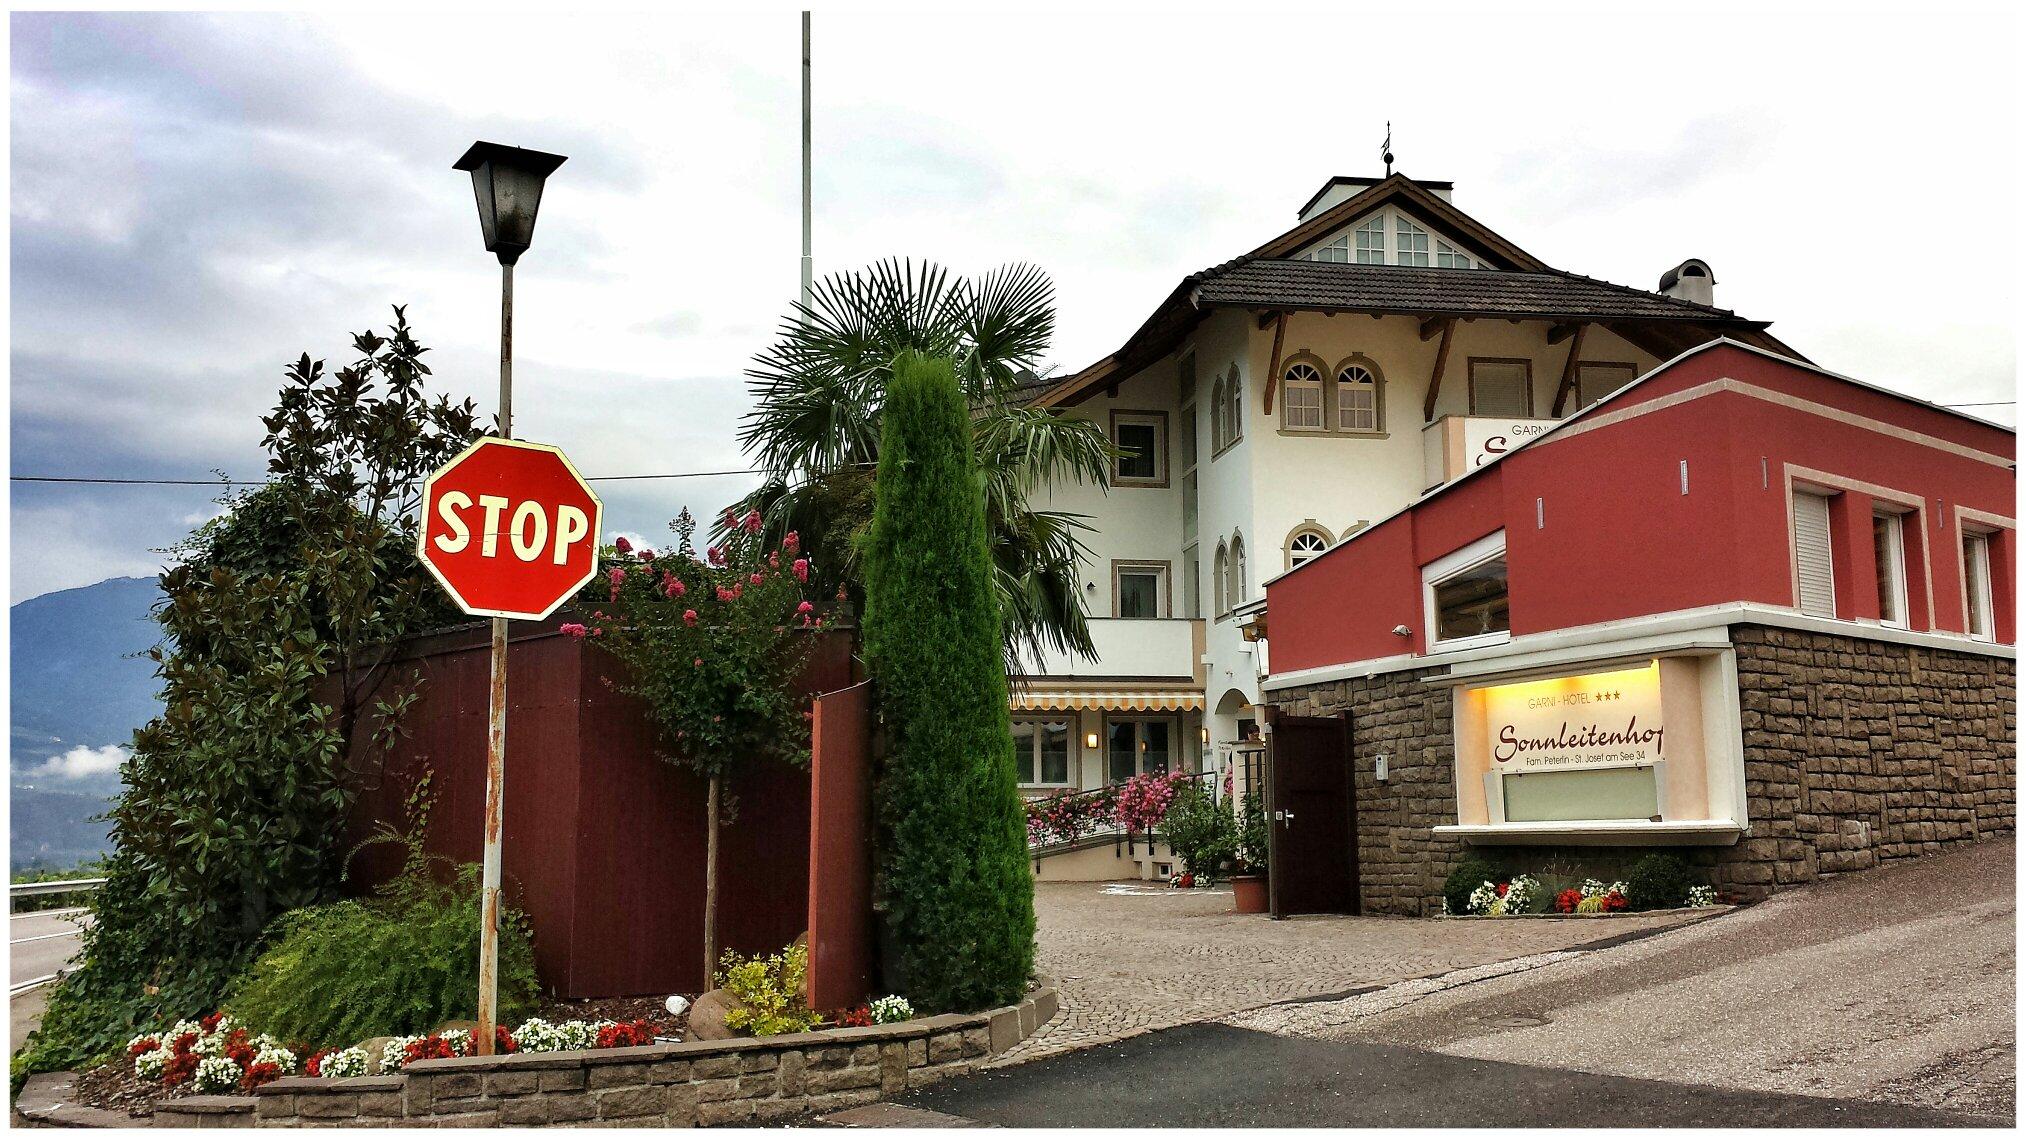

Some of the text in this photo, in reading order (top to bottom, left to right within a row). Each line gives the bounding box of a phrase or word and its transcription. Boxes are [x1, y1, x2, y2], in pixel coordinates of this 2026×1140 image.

[434, 490, 588, 566] STOP
[1528, 697, 1556, 709] GARNI
[1562, 692, 1591, 706] HOTEL
[1605, 754, 1619, 762] am
[1620, 751, 1635, 761] See
[1636, 750, 1646, 760] 34
